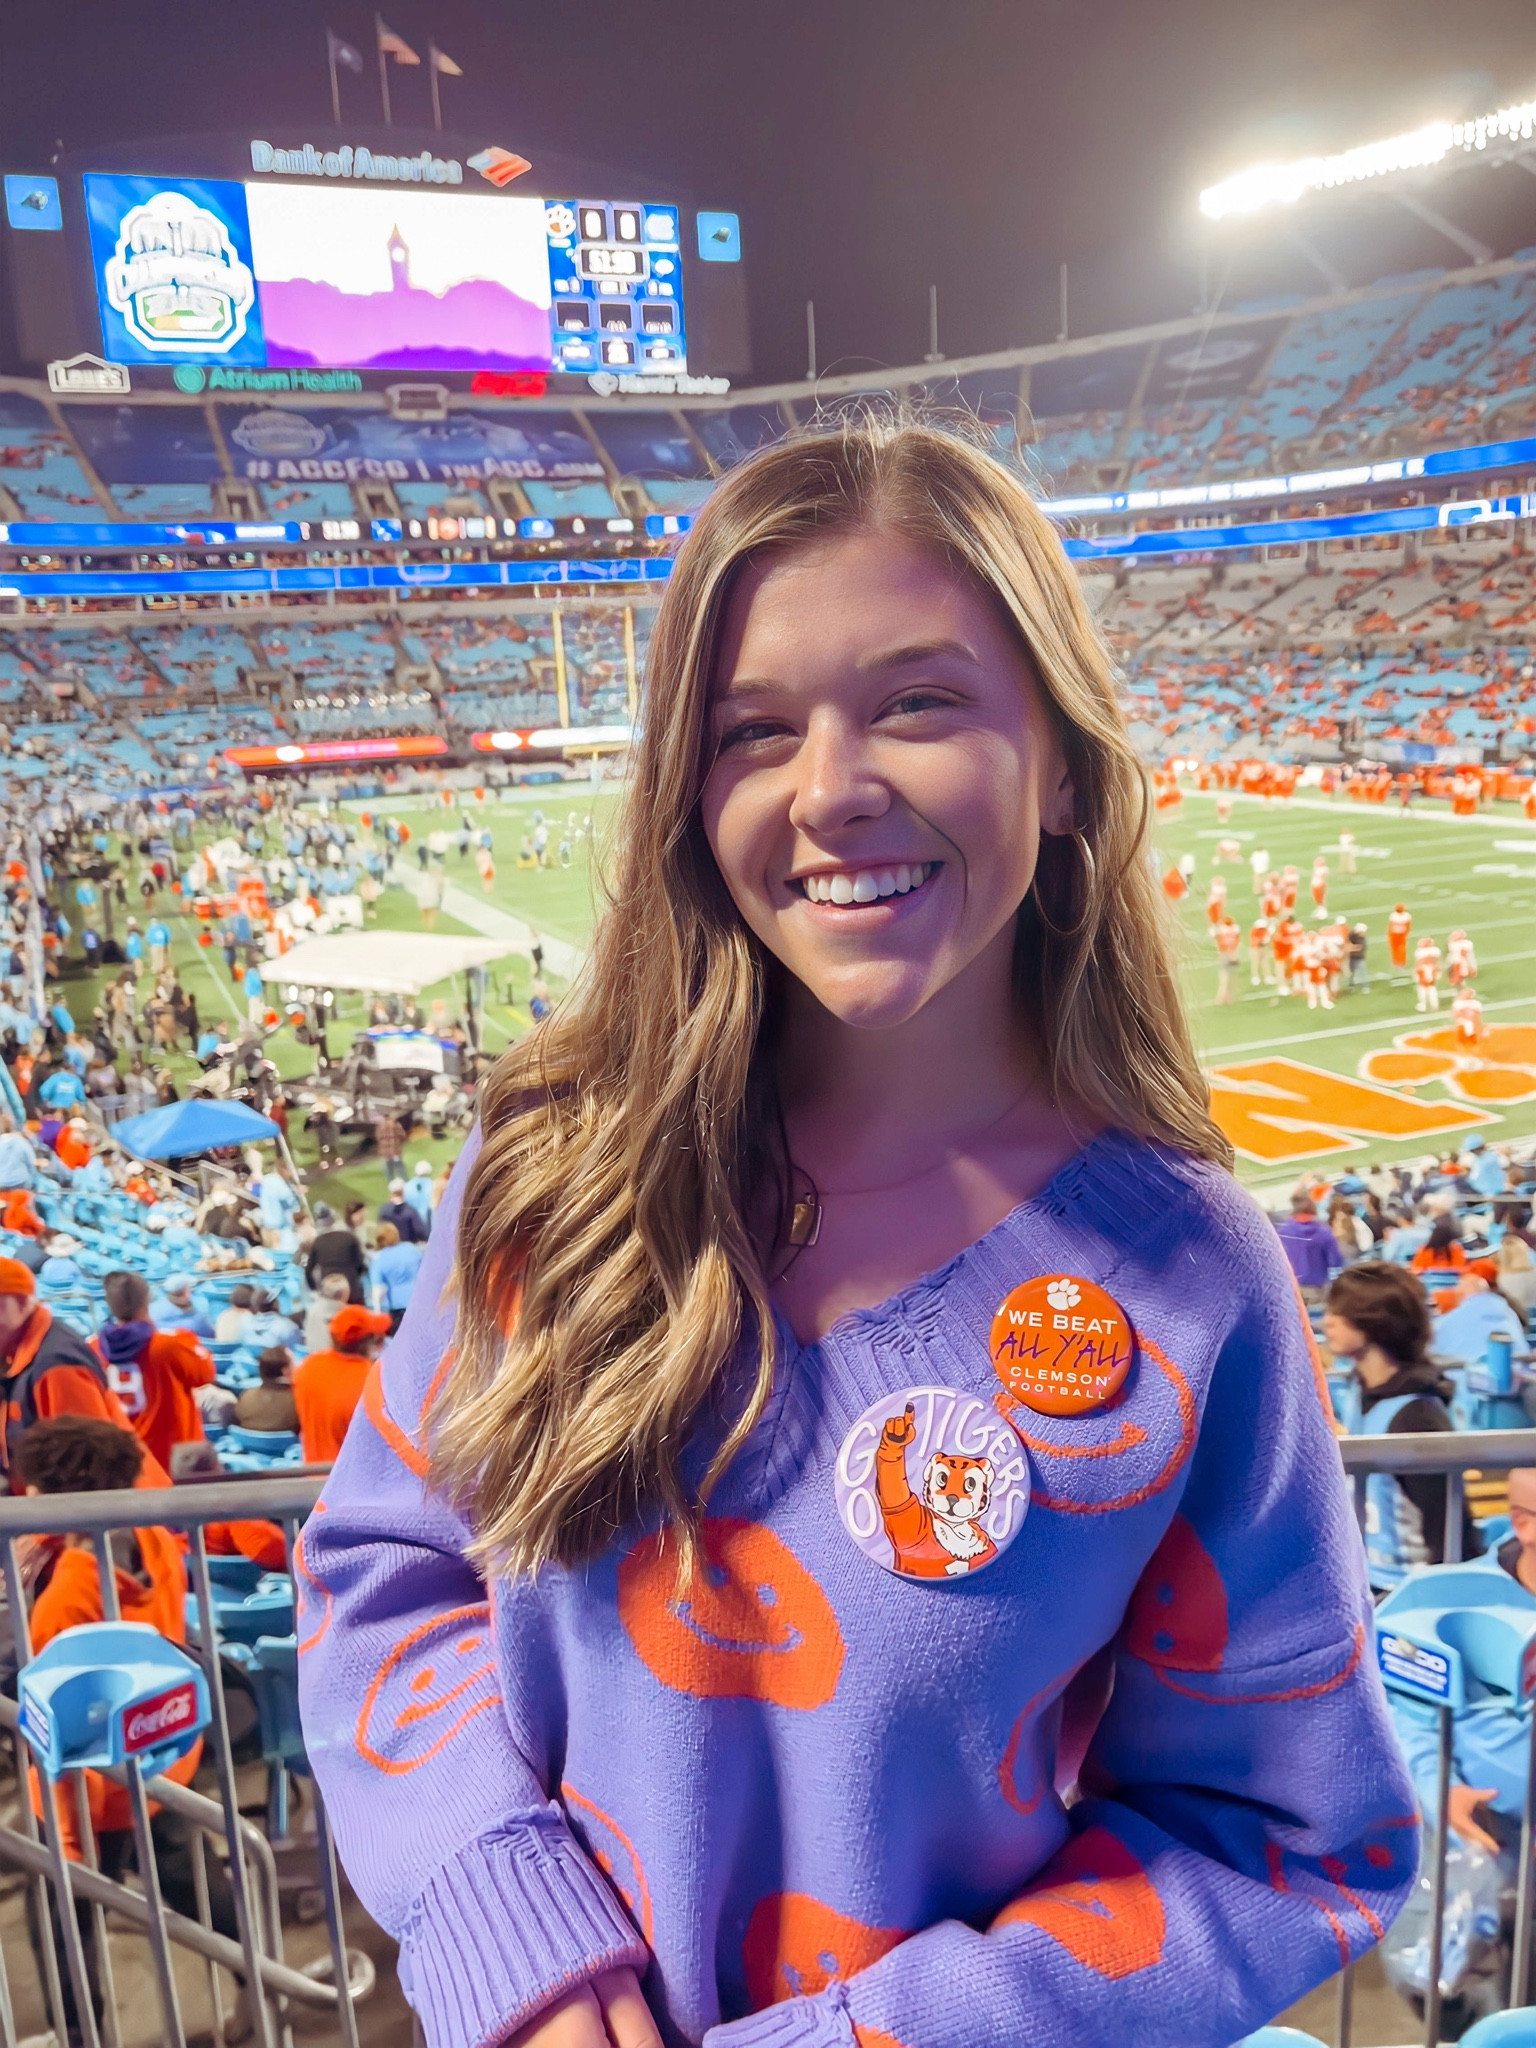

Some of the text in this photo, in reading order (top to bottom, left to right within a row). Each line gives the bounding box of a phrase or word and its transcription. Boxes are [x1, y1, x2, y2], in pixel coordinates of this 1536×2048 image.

[251, 140, 463, 184] Bank of America
[209, 367, 363, 392] Atrium Health
[1008, 1309, 1118, 1335] WE BEAT
[995, 1330, 1129, 1368] ALL Y'ALL
[1010, 1366, 1107, 1387] CLEMSON
[1009, 1381, 1106, 1400] FOOTBALL
[839, 1387, 1027, 1540] GO TIGERS
